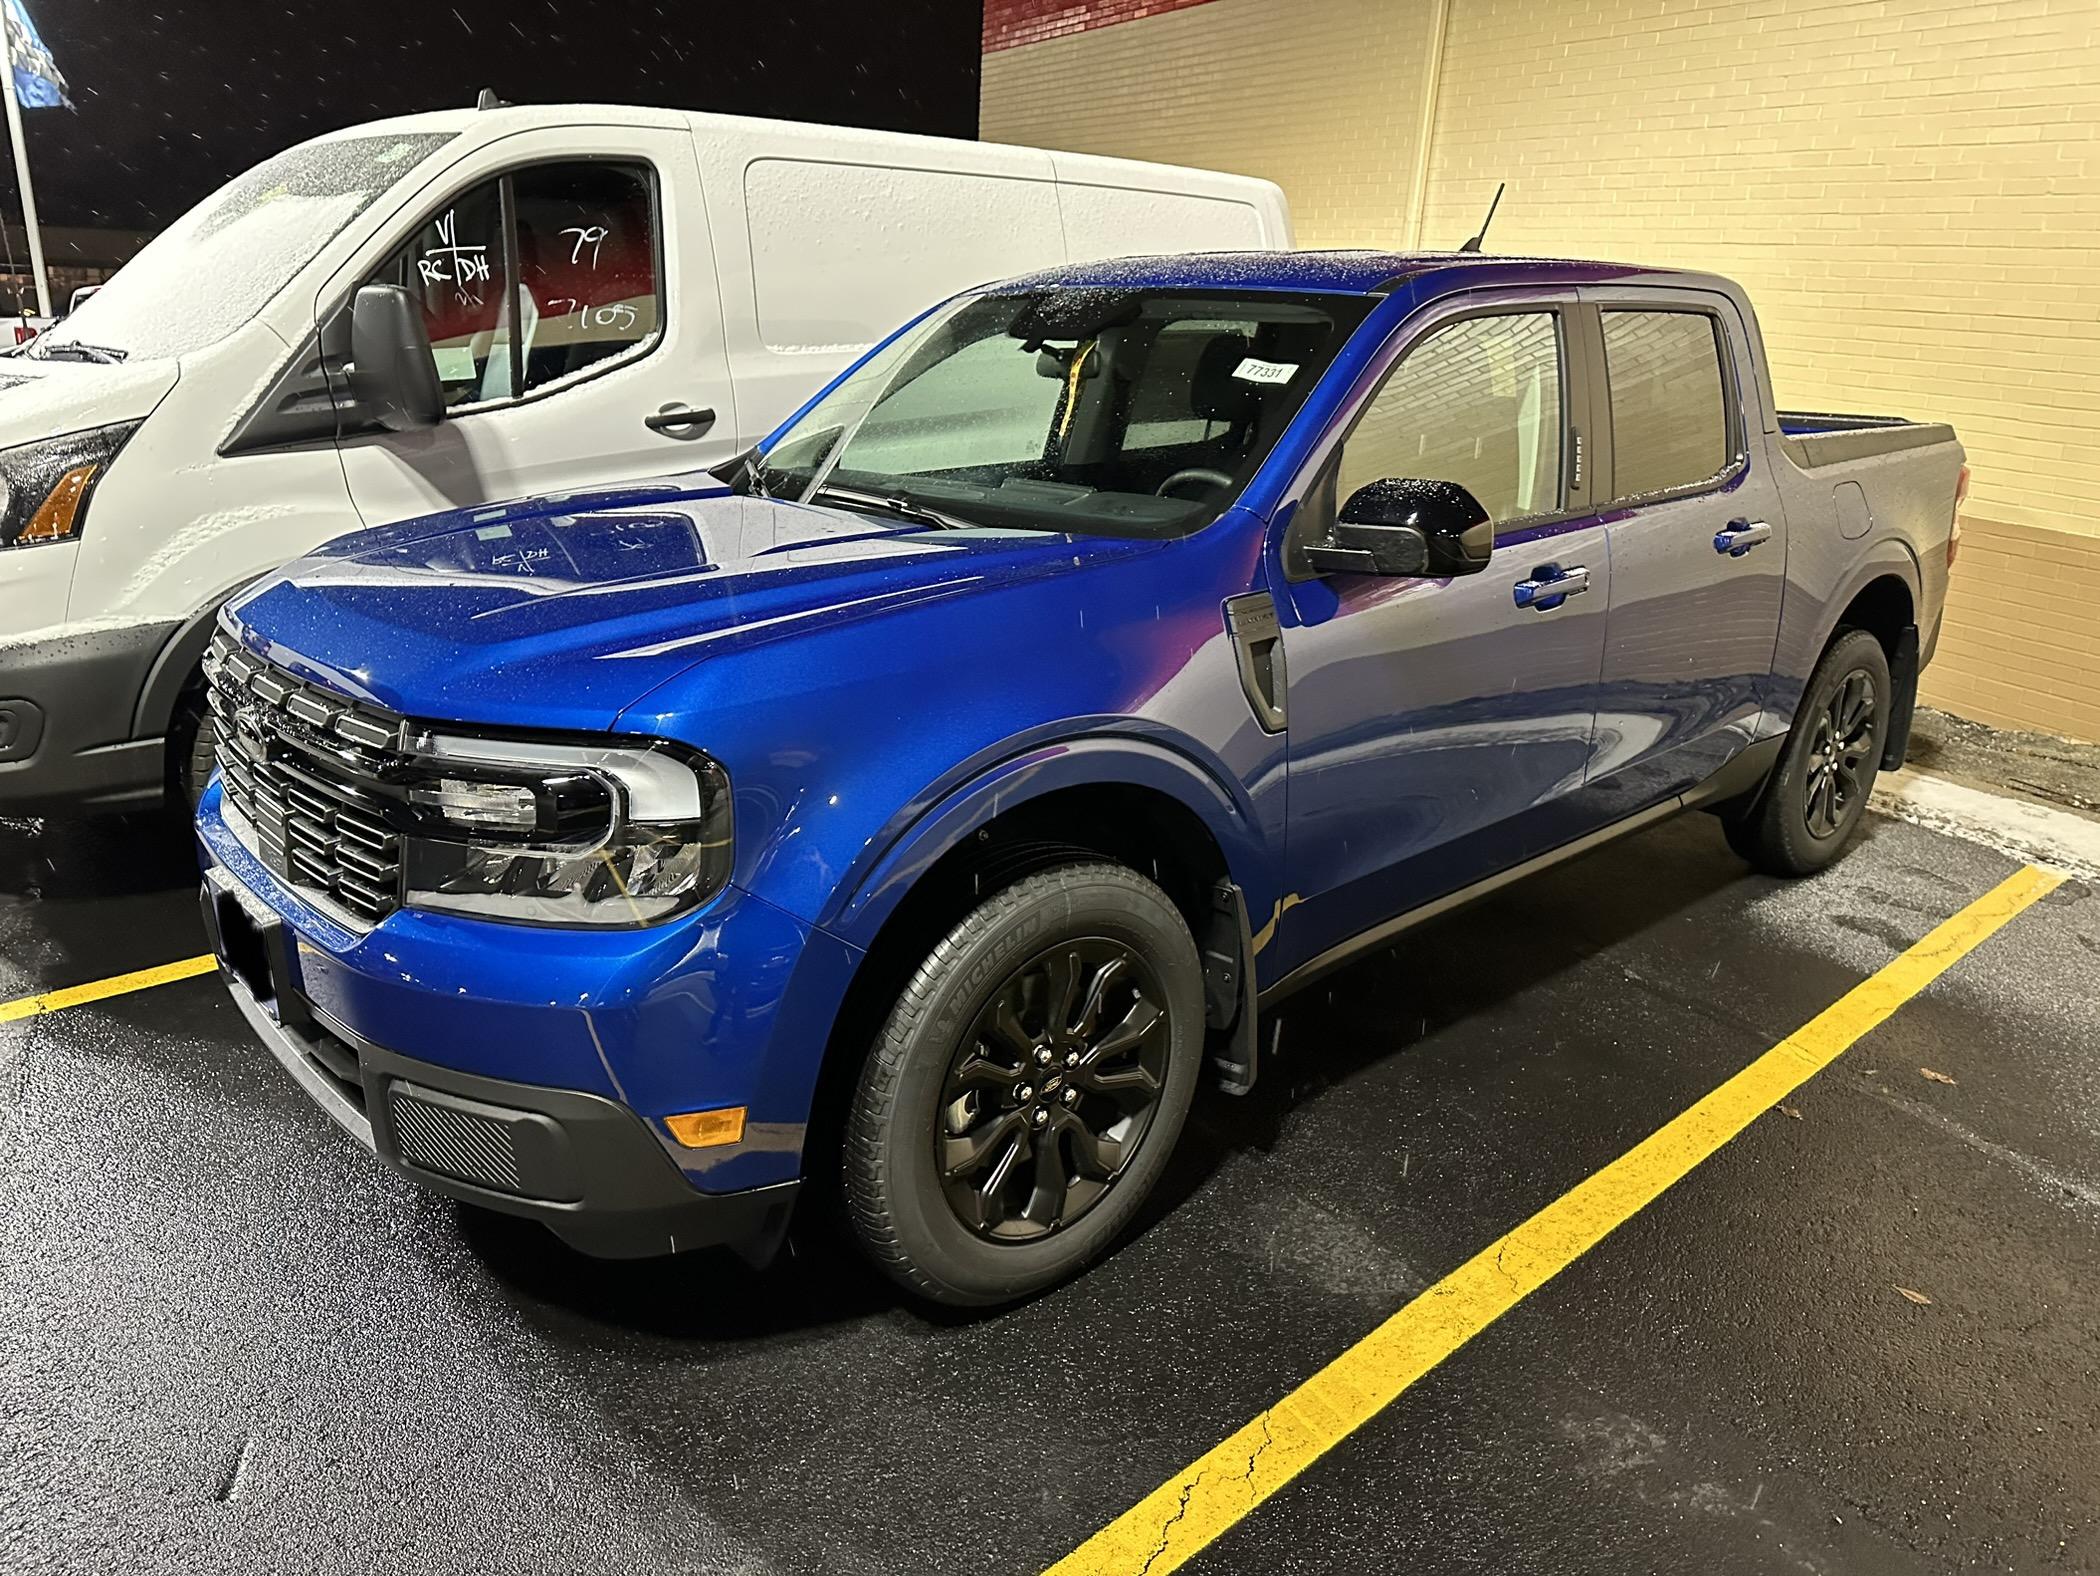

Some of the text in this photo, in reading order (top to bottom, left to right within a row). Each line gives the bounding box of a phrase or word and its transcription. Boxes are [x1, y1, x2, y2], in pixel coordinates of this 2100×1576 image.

[558, 226, 609, 271] 79
[1247, 364, 1283, 377] 77331
[950, 917, 1039, 1015] MICHELIN
